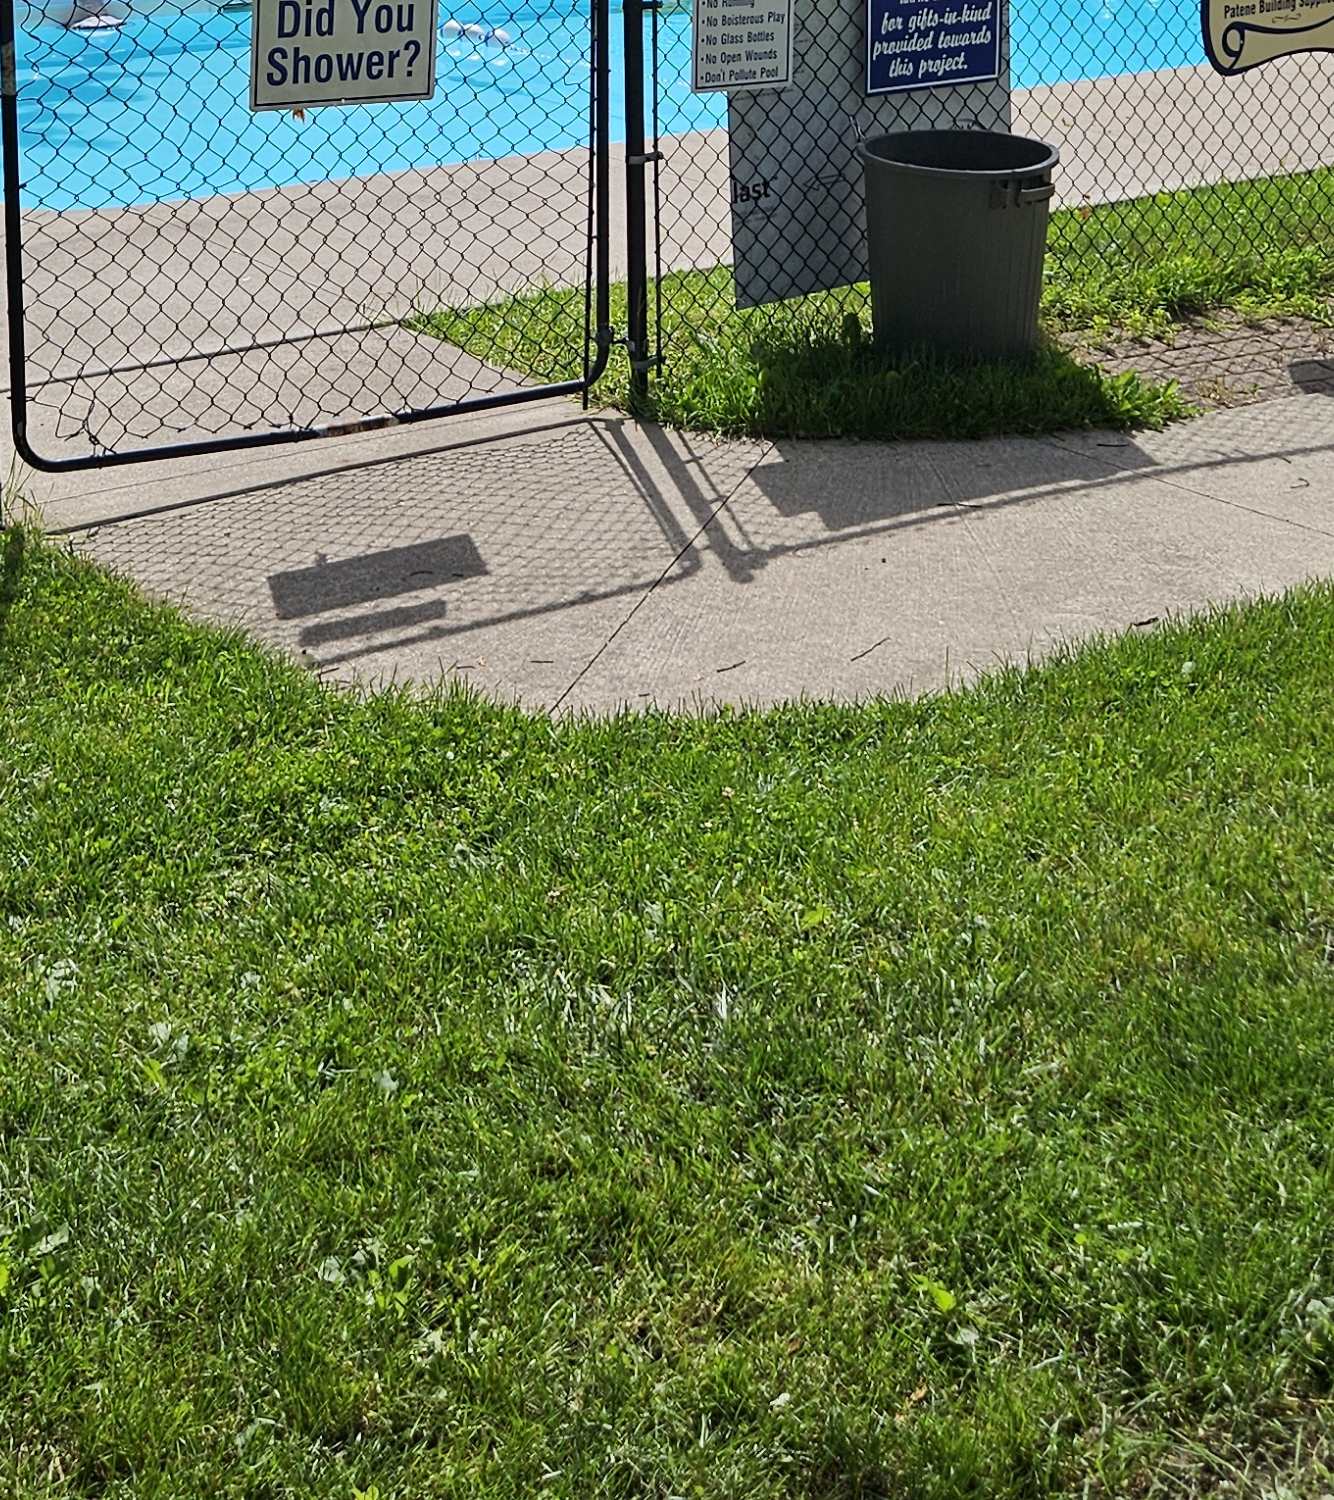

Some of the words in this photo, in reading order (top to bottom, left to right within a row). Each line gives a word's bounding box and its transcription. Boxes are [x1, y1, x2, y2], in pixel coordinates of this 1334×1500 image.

[882, 12, 902, 35] for
[908, 2, 992, 33] gifts-in-kind
[1224, 2, 1256, 19] Patene
[706, 16, 717, 27] No
[722, 13, 764, 26] Boisterous
[768, 12, 785, 24] Play
[706, 35, 717, 45] No
[721, 33, 743, 45] Glass
[747, 31, 775, 43] Bottles
[873, 32, 932, 60] provided
[938, 25, 991, 49] towards
[267, 40, 421, 85] Shower?
[705, 54, 716, 64] No
[721, 52, 741, 65] Open
[745, 49, 777, 61] Wounds
[705, 69, 725, 83] Don't
[729, 69, 757, 81] Pollute
[760, 66, 778, 78] Pool
[889, 58, 913, 78] this
[918, 53, 967, 79] project.
